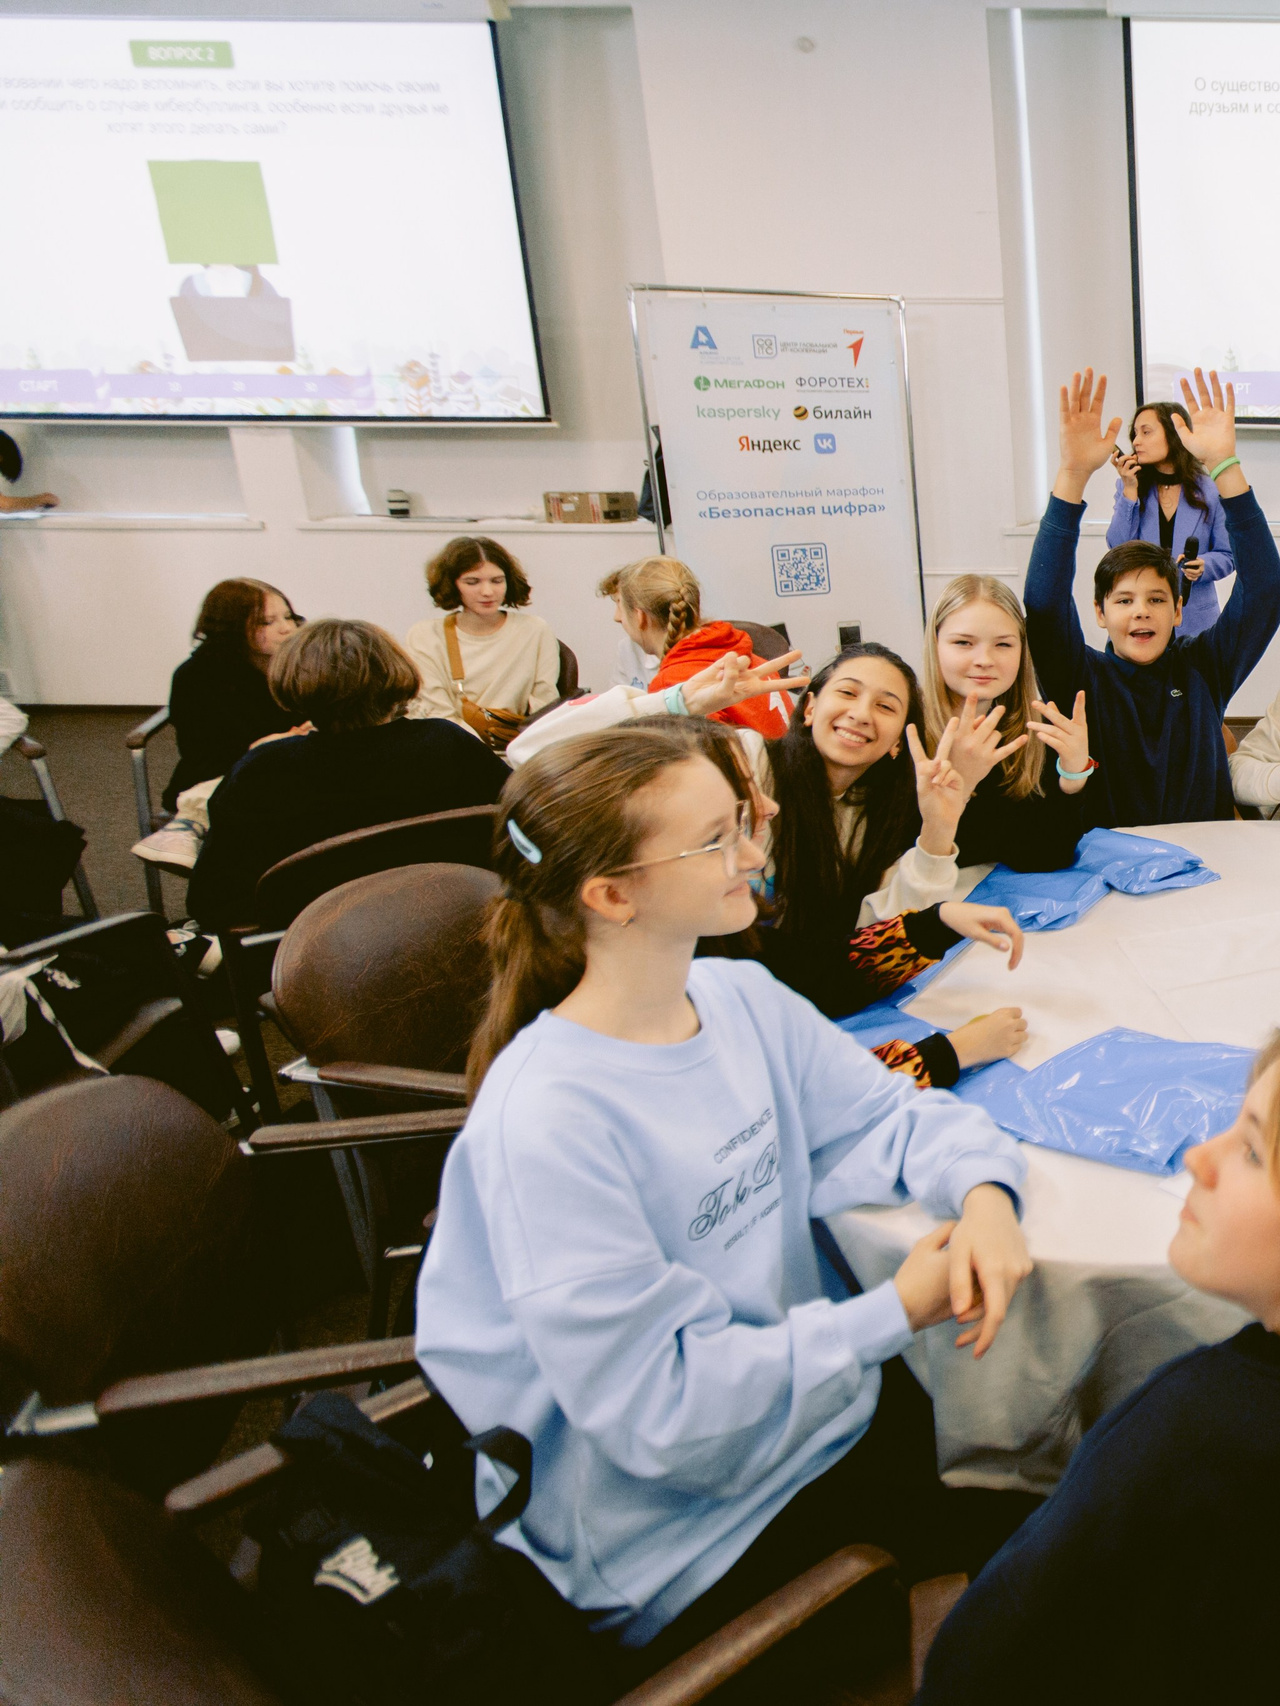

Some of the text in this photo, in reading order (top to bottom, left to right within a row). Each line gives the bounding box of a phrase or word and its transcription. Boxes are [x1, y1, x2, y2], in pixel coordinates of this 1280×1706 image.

[148, 46, 215, 62] ВОПРОС 2
[67, 78, 99, 90] чего
[103, 79, 138, 92] надо
[1194, 77, 1206, 91] О
[1189, 101, 1249, 117] друзьям
[1254, 102, 1263, 114] и
[696, 404, 781, 421] kaspersky
[812, 405, 872, 420] билайн
[738, 435, 801, 453] Яндекс
[696, 485, 885, 502] Образовательный марафон
[698, 501, 886, 519] «Безопасная цифра»
[713, 1108, 773, 1164] CONFIDENCE
